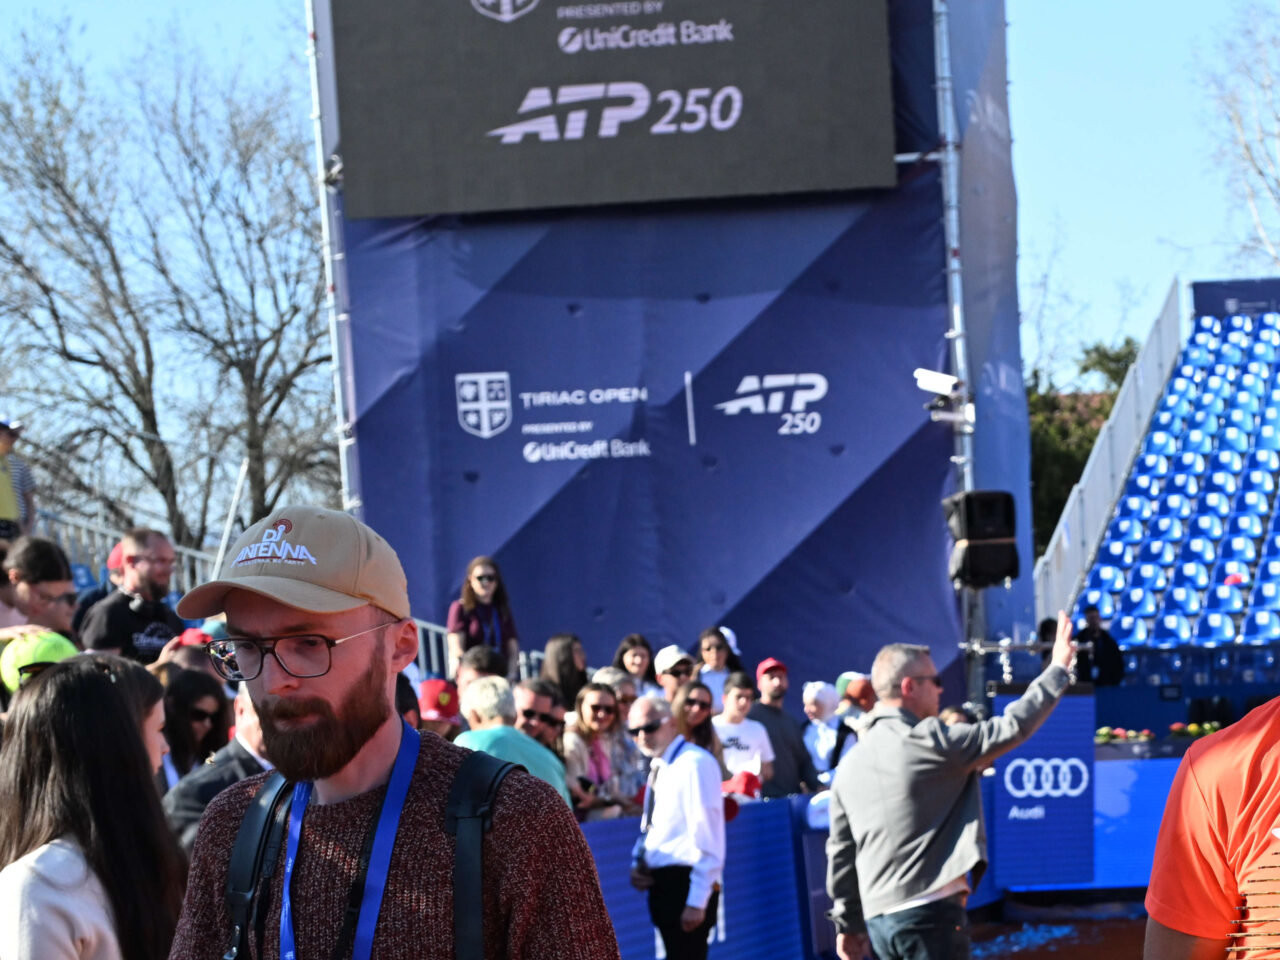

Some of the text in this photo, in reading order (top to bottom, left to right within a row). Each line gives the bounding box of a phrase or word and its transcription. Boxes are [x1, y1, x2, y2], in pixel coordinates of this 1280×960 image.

[556, 1, 664, 18] PRESENTED BY
[584, 18, 734, 51] UniCredit Bank
[485, 82, 743, 144] ATP 250
[588, 387, 648, 405] OPEN
[714, 373, 828, 415] ATP
[777, 411, 821, 435] 250
[541, 438, 651, 461] UniCredit Bank
[230, 540, 317, 568] ANTENNA
[1008, 805, 1045, 820] Audi
